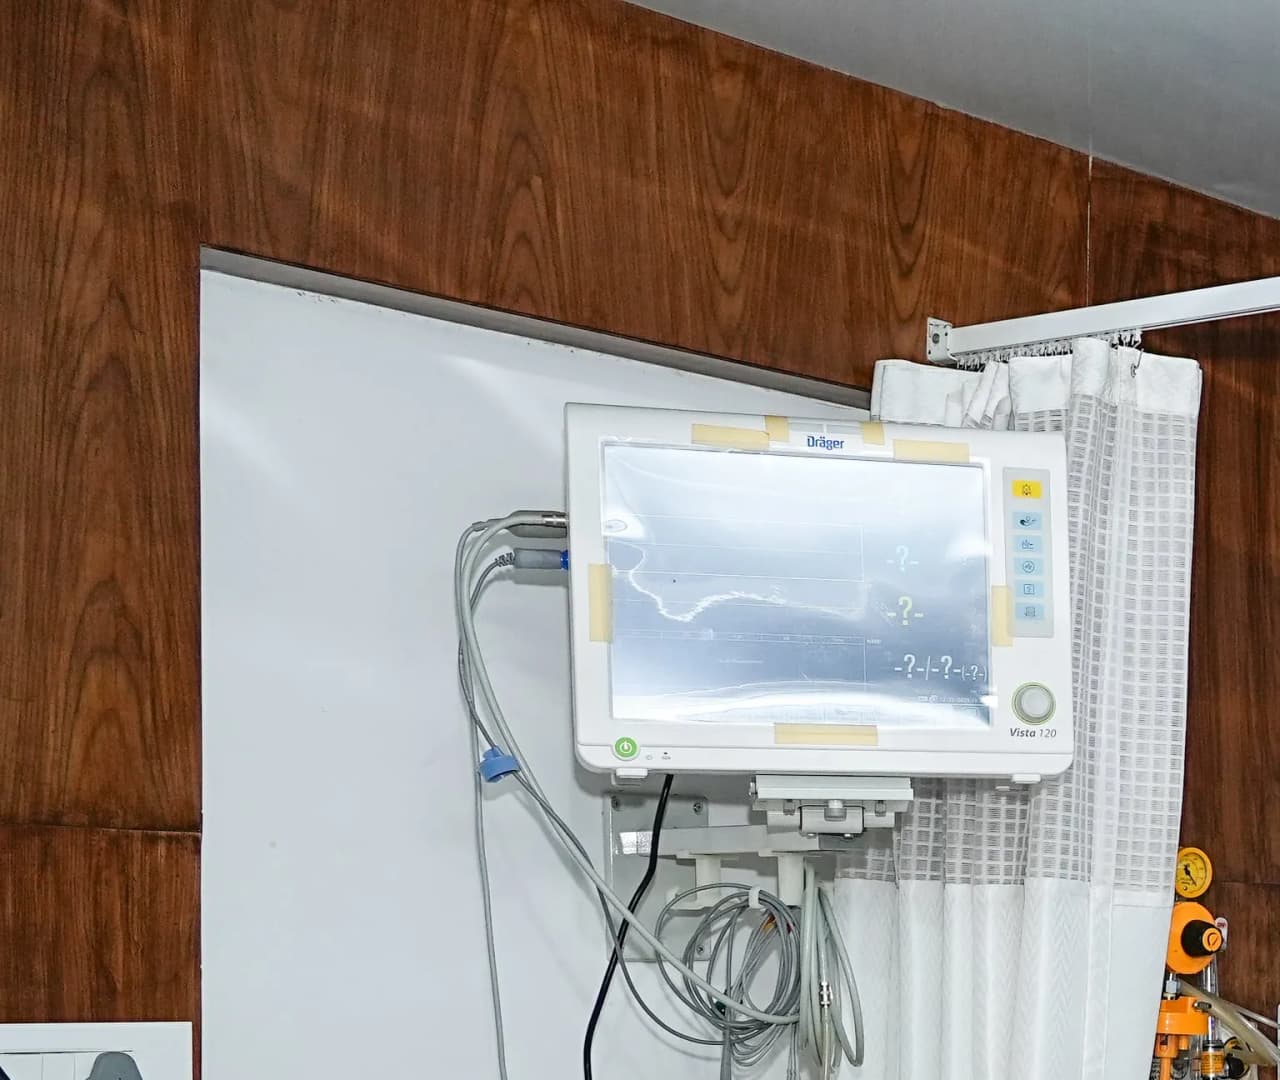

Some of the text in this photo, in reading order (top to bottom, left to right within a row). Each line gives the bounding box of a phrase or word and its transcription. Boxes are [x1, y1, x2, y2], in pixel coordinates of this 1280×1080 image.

[807, 434, 844, 451] Dräger
[1009, 727, 1057, 738] Vista 120
